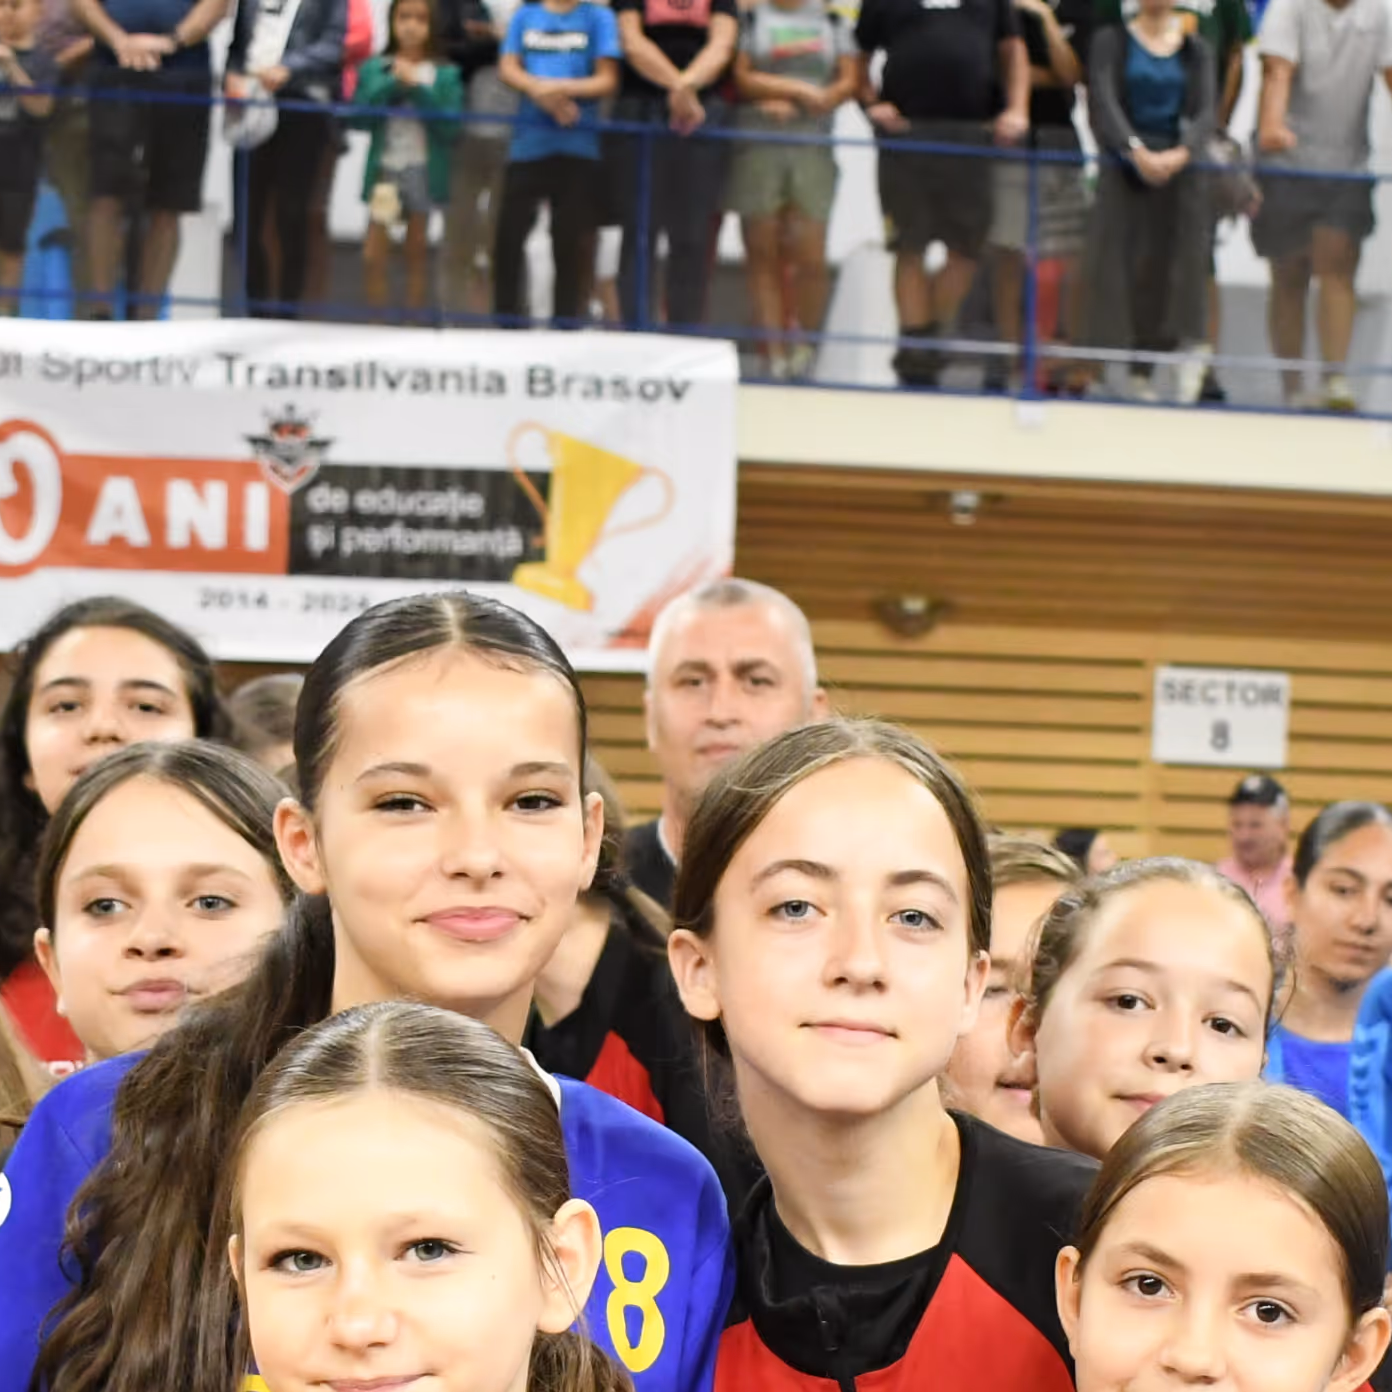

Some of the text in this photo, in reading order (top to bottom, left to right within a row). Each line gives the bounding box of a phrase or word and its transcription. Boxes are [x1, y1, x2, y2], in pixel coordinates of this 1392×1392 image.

[38, 350, 200, 389] Sportiv
[214, 351, 506, 395] Transilvania
[86, 475, 271, 552] ANI
[307, 482, 349, 514] de
[1162, 680, 1283, 706] SECTOR
[1210, 719, 1231, 751] 8
